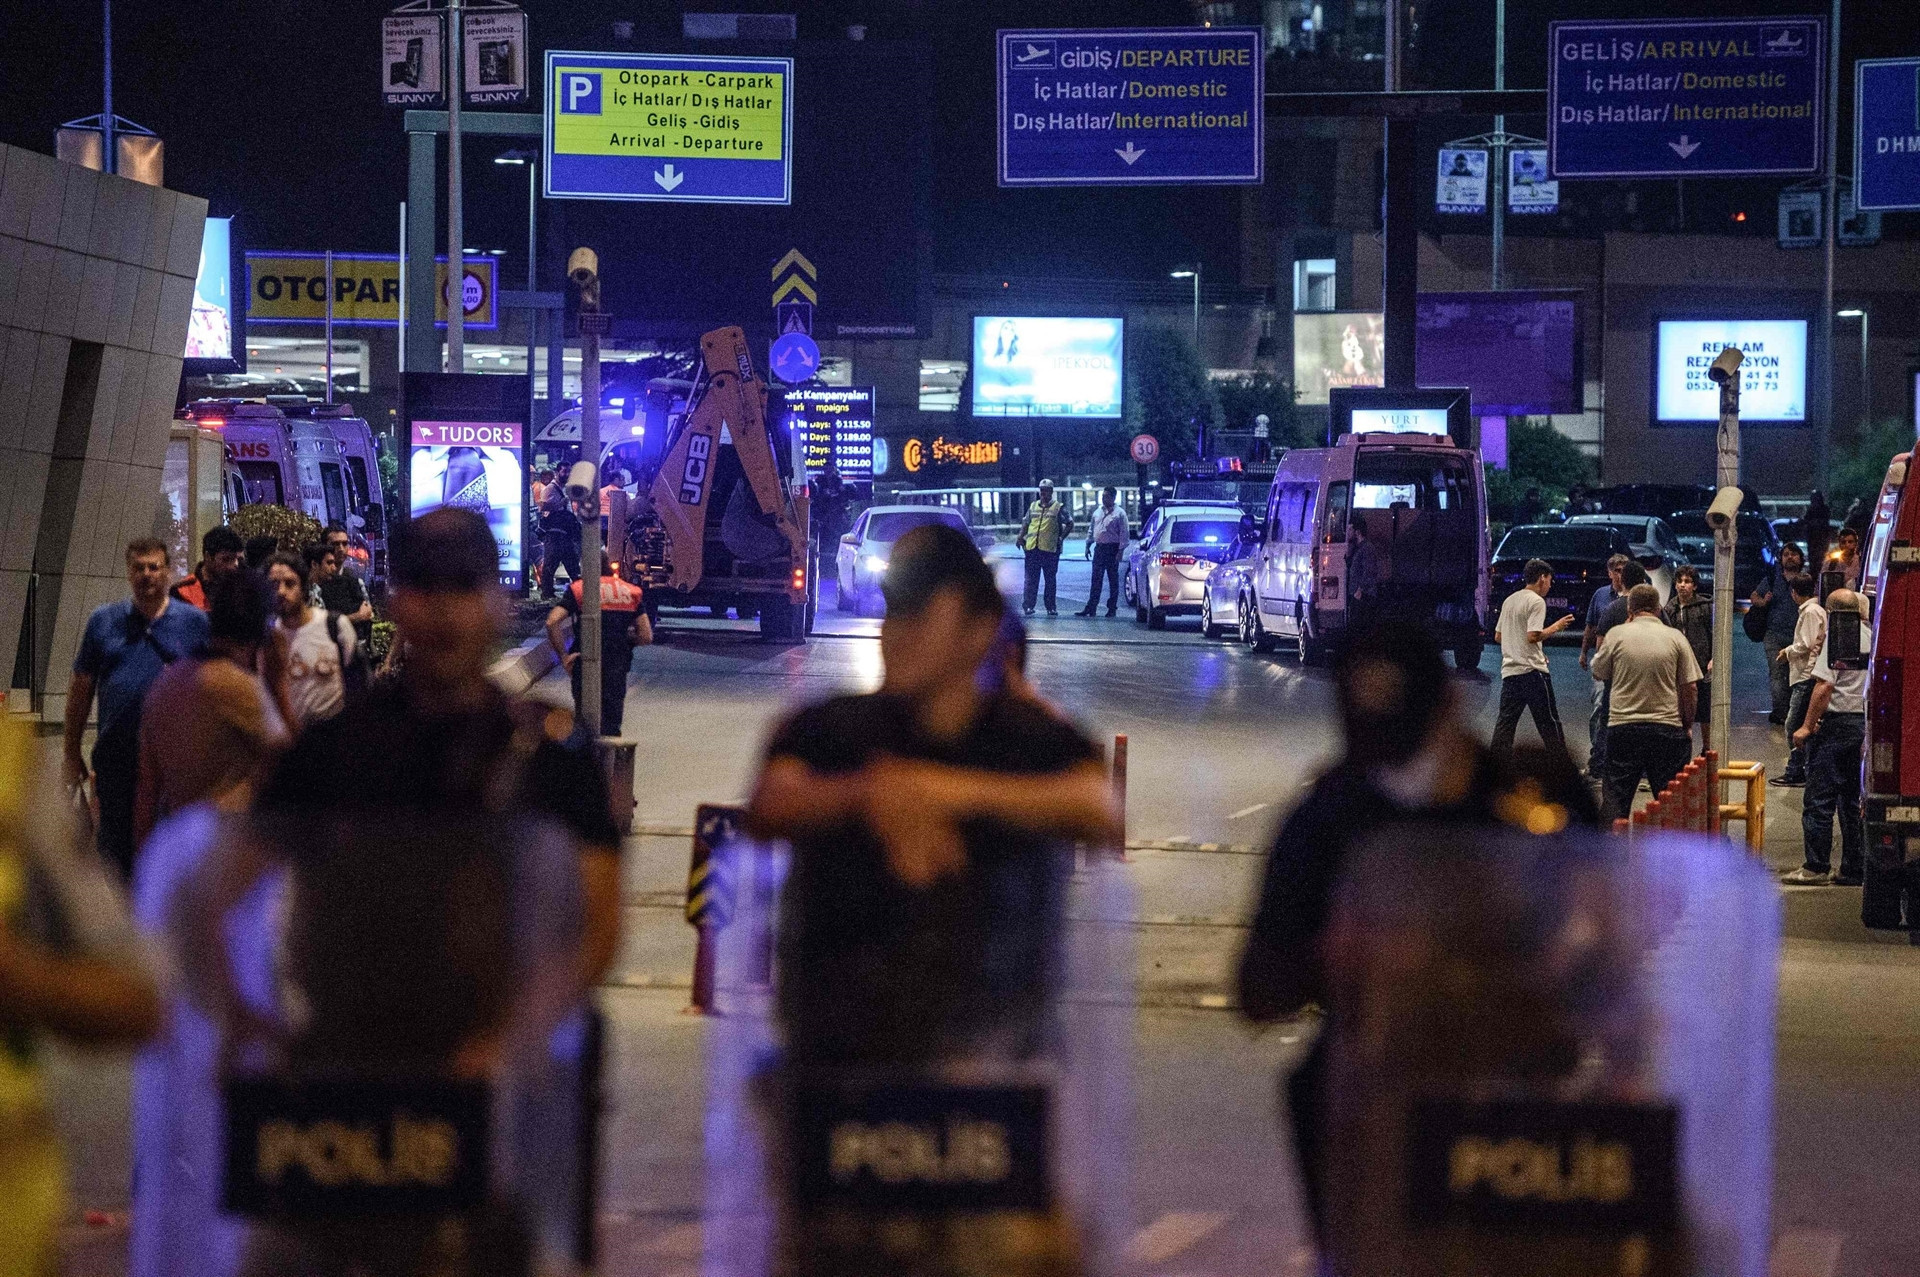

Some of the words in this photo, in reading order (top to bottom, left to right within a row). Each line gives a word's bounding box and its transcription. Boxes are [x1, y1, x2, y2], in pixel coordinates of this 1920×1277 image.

[619, 70, 689, 88] Otopark
[1585, 70, 1604, 94] İç
[470, 92, 520, 103] SUNNY
[569, 76, 593, 111] P
[1034, 77, 1051, 101] İç
[387, 94, 436, 104] SUNNY
[613, 88, 627, 107] İç
[724, 94, 773, 109] Hatlar
[647, 113, 687, 129] Geliş
[1013, 113, 1046, 132] Dış
[609, 133, 666, 148] Arrival
[256, 275, 402, 303] OTOPAR
[1686, 356, 1780, 367] REZSYON
[1381, 415, 1421, 425] YURT
[439, 426, 514, 443] TUDORS
[1137, 442, 1154, 455] 30
[680, 434, 712, 504] JCB
